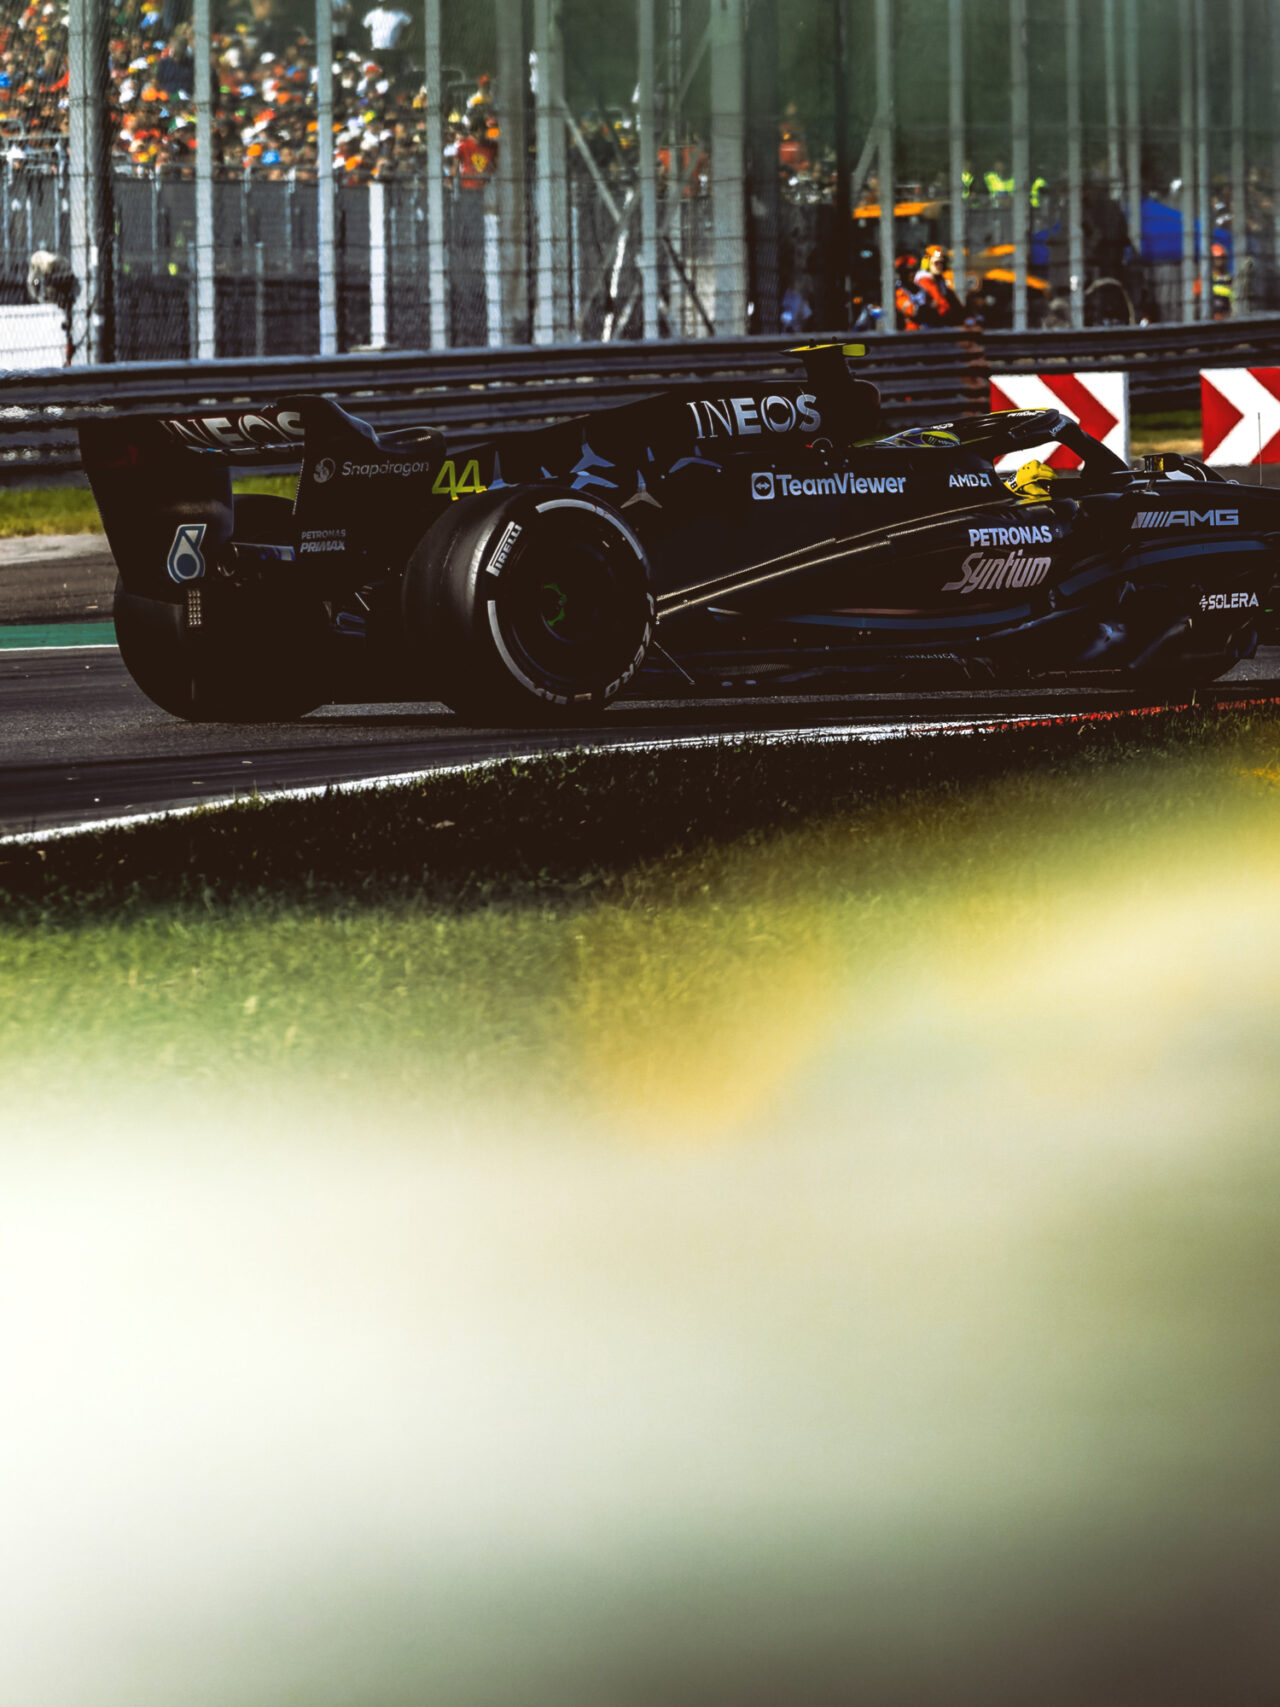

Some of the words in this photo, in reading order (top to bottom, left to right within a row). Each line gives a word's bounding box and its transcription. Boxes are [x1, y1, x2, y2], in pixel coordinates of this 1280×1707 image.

[687, 394, 820, 440] INEOS
[341, 460, 429, 477] Snapdragon
[432, 459, 486, 500] 44
[776, 472, 906, 497] TeamViewer
[949, 473, 979, 488] AMD
[1165, 508, 1239, 528] AMG
[300, 529, 346, 541] PETRONAS
[968, 524, 1053, 547] PETRONAS
[299, 541, 346, 553] PRIMAX
[485, 520, 523, 577] PIRELLI
[941, 549, 1053, 593] Syntium
[1208, 592, 1259, 610] SOLERA
